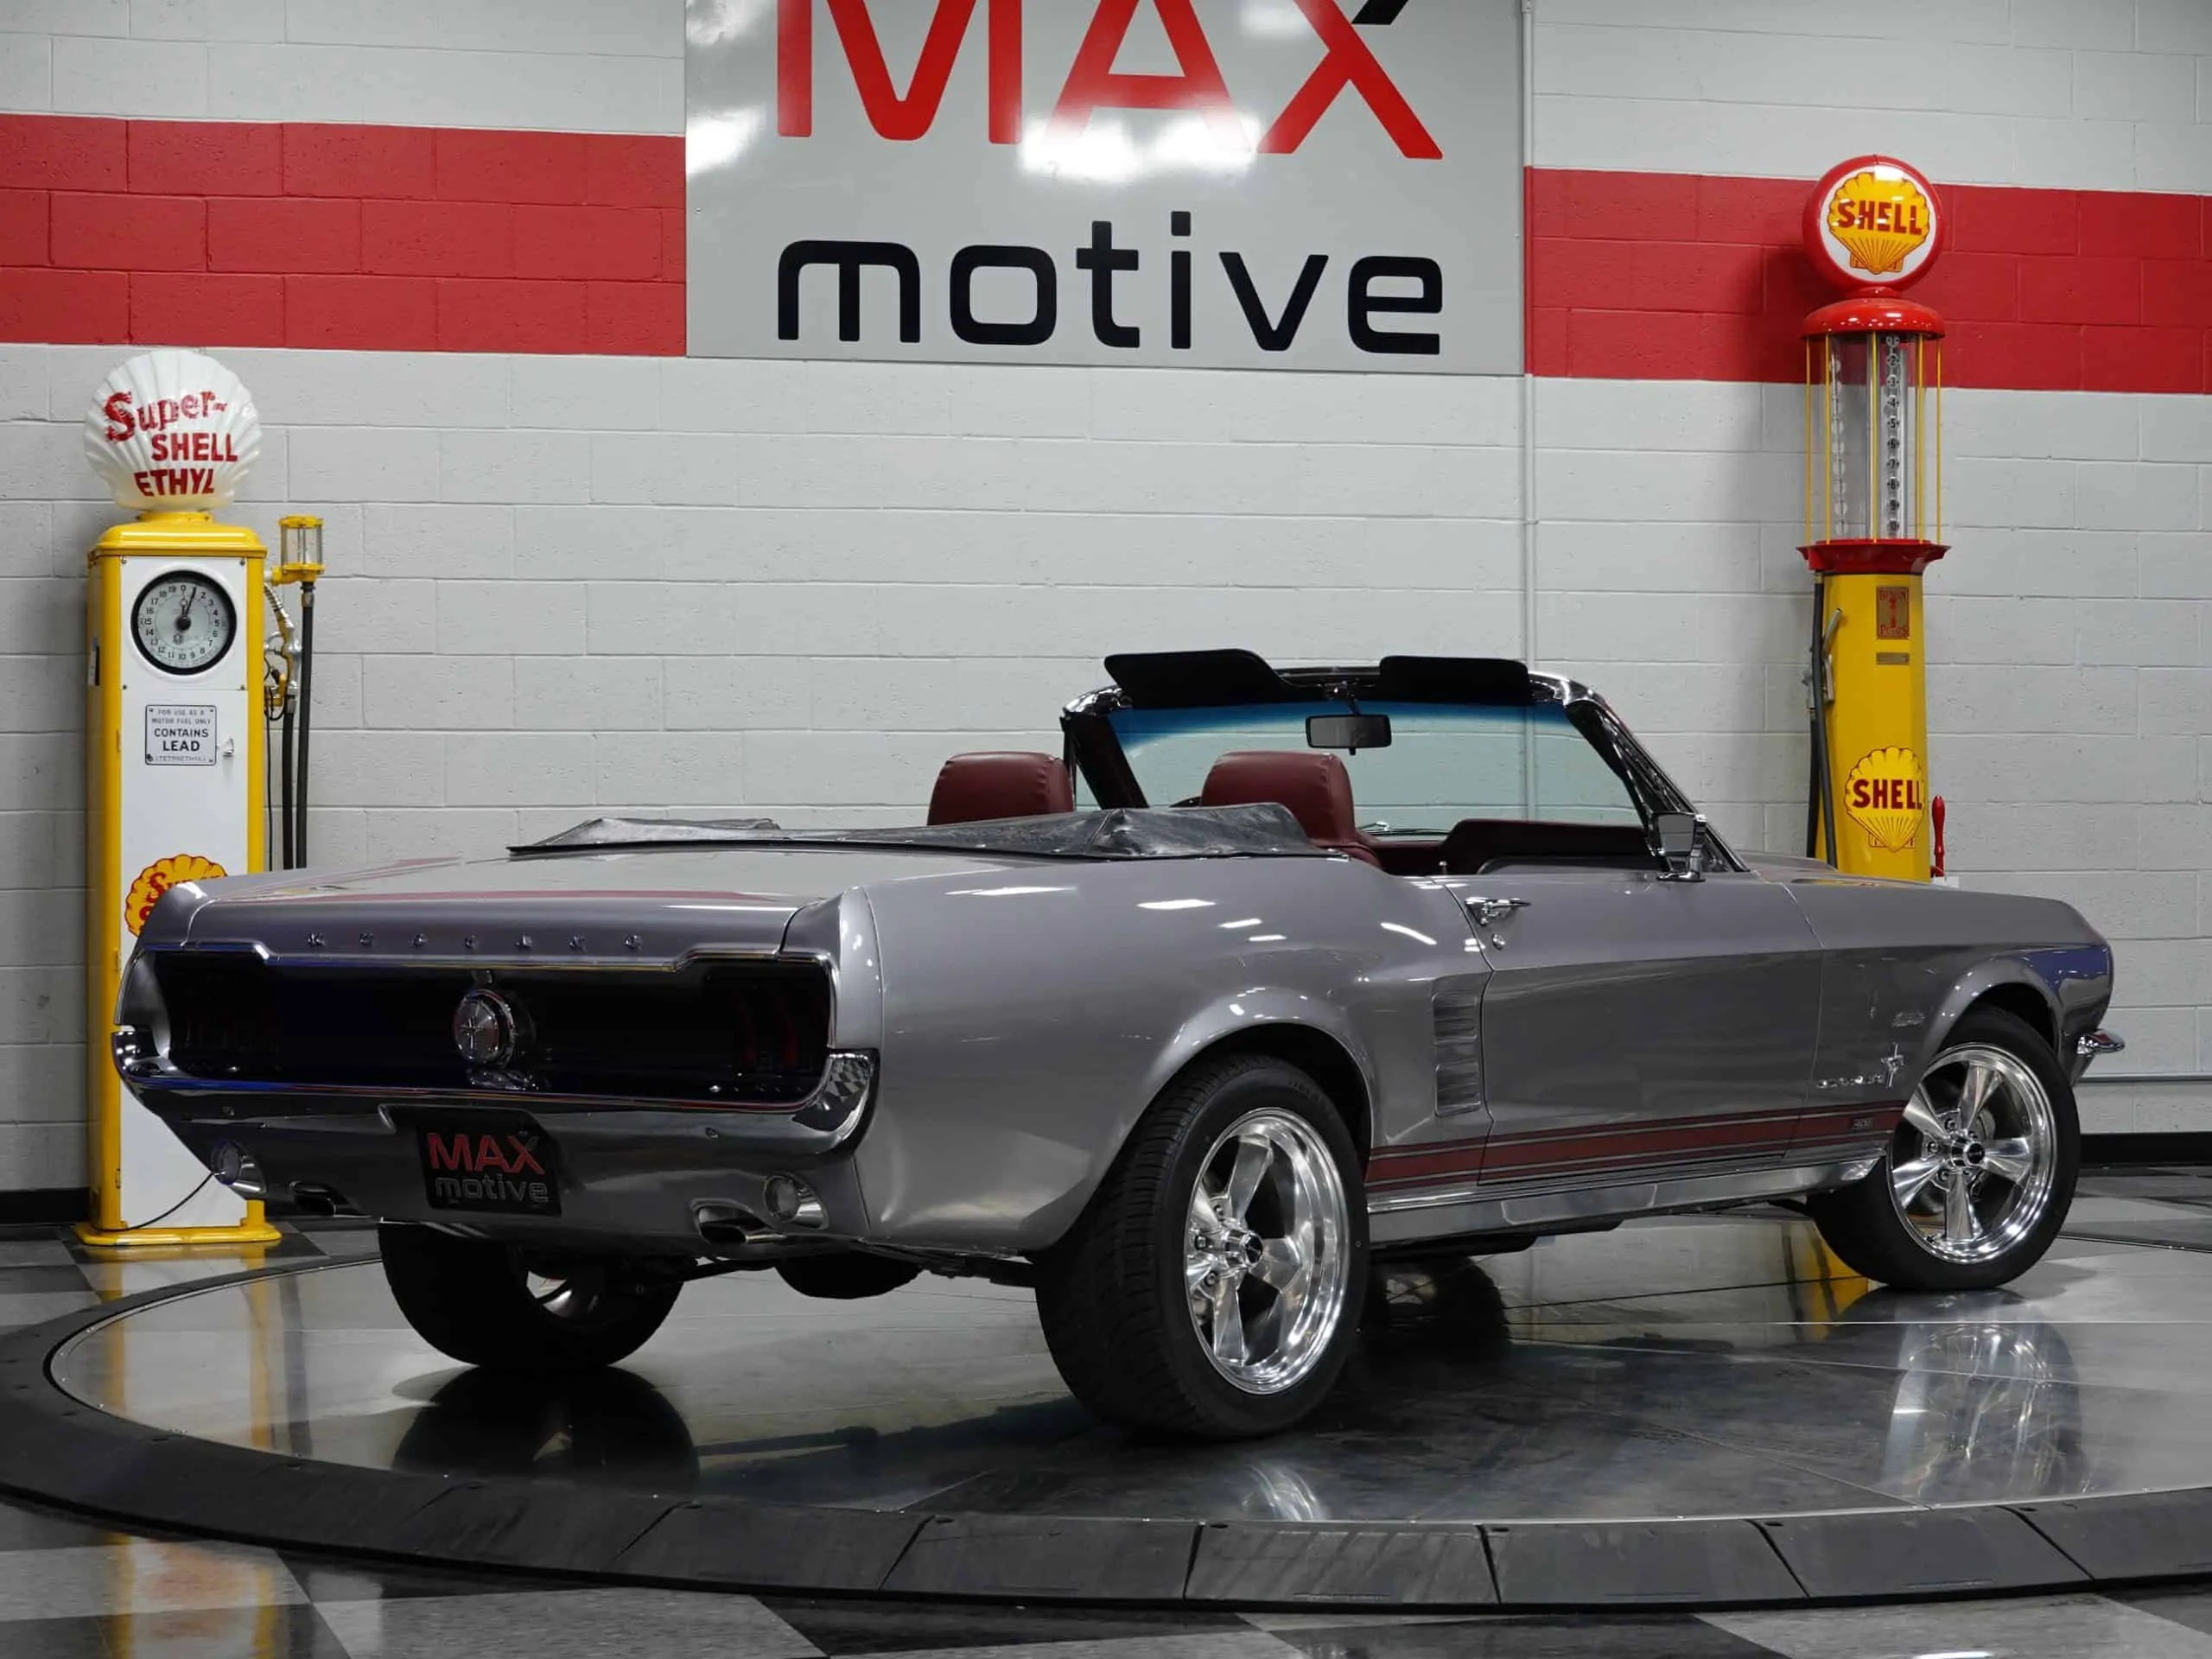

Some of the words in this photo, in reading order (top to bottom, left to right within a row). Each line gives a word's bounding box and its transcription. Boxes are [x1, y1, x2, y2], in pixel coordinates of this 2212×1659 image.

[777, 0, 1443, 160] MAX
[1837, 200, 1923, 236] SHELL
[777, 211, 1443, 355] motive
[104, 391, 228, 444] Super-
[150, 432, 238, 463] SHELL
[133, 467, 215, 497] ETHYL
[200, 591, 207, 600] 2
[144, 617, 152, 626] 15
[212, 629, 218, 638] 6
[213, 619, 220, 627] 5
[189, 651, 196, 659] 9
[154, 728, 209, 738] CONTAINS
[162, 740, 200, 752] LEAD
[1852, 779, 1923, 810] SHELL
[428, 1132, 546, 1175] MAX
[435, 1173, 550, 1204] motive
